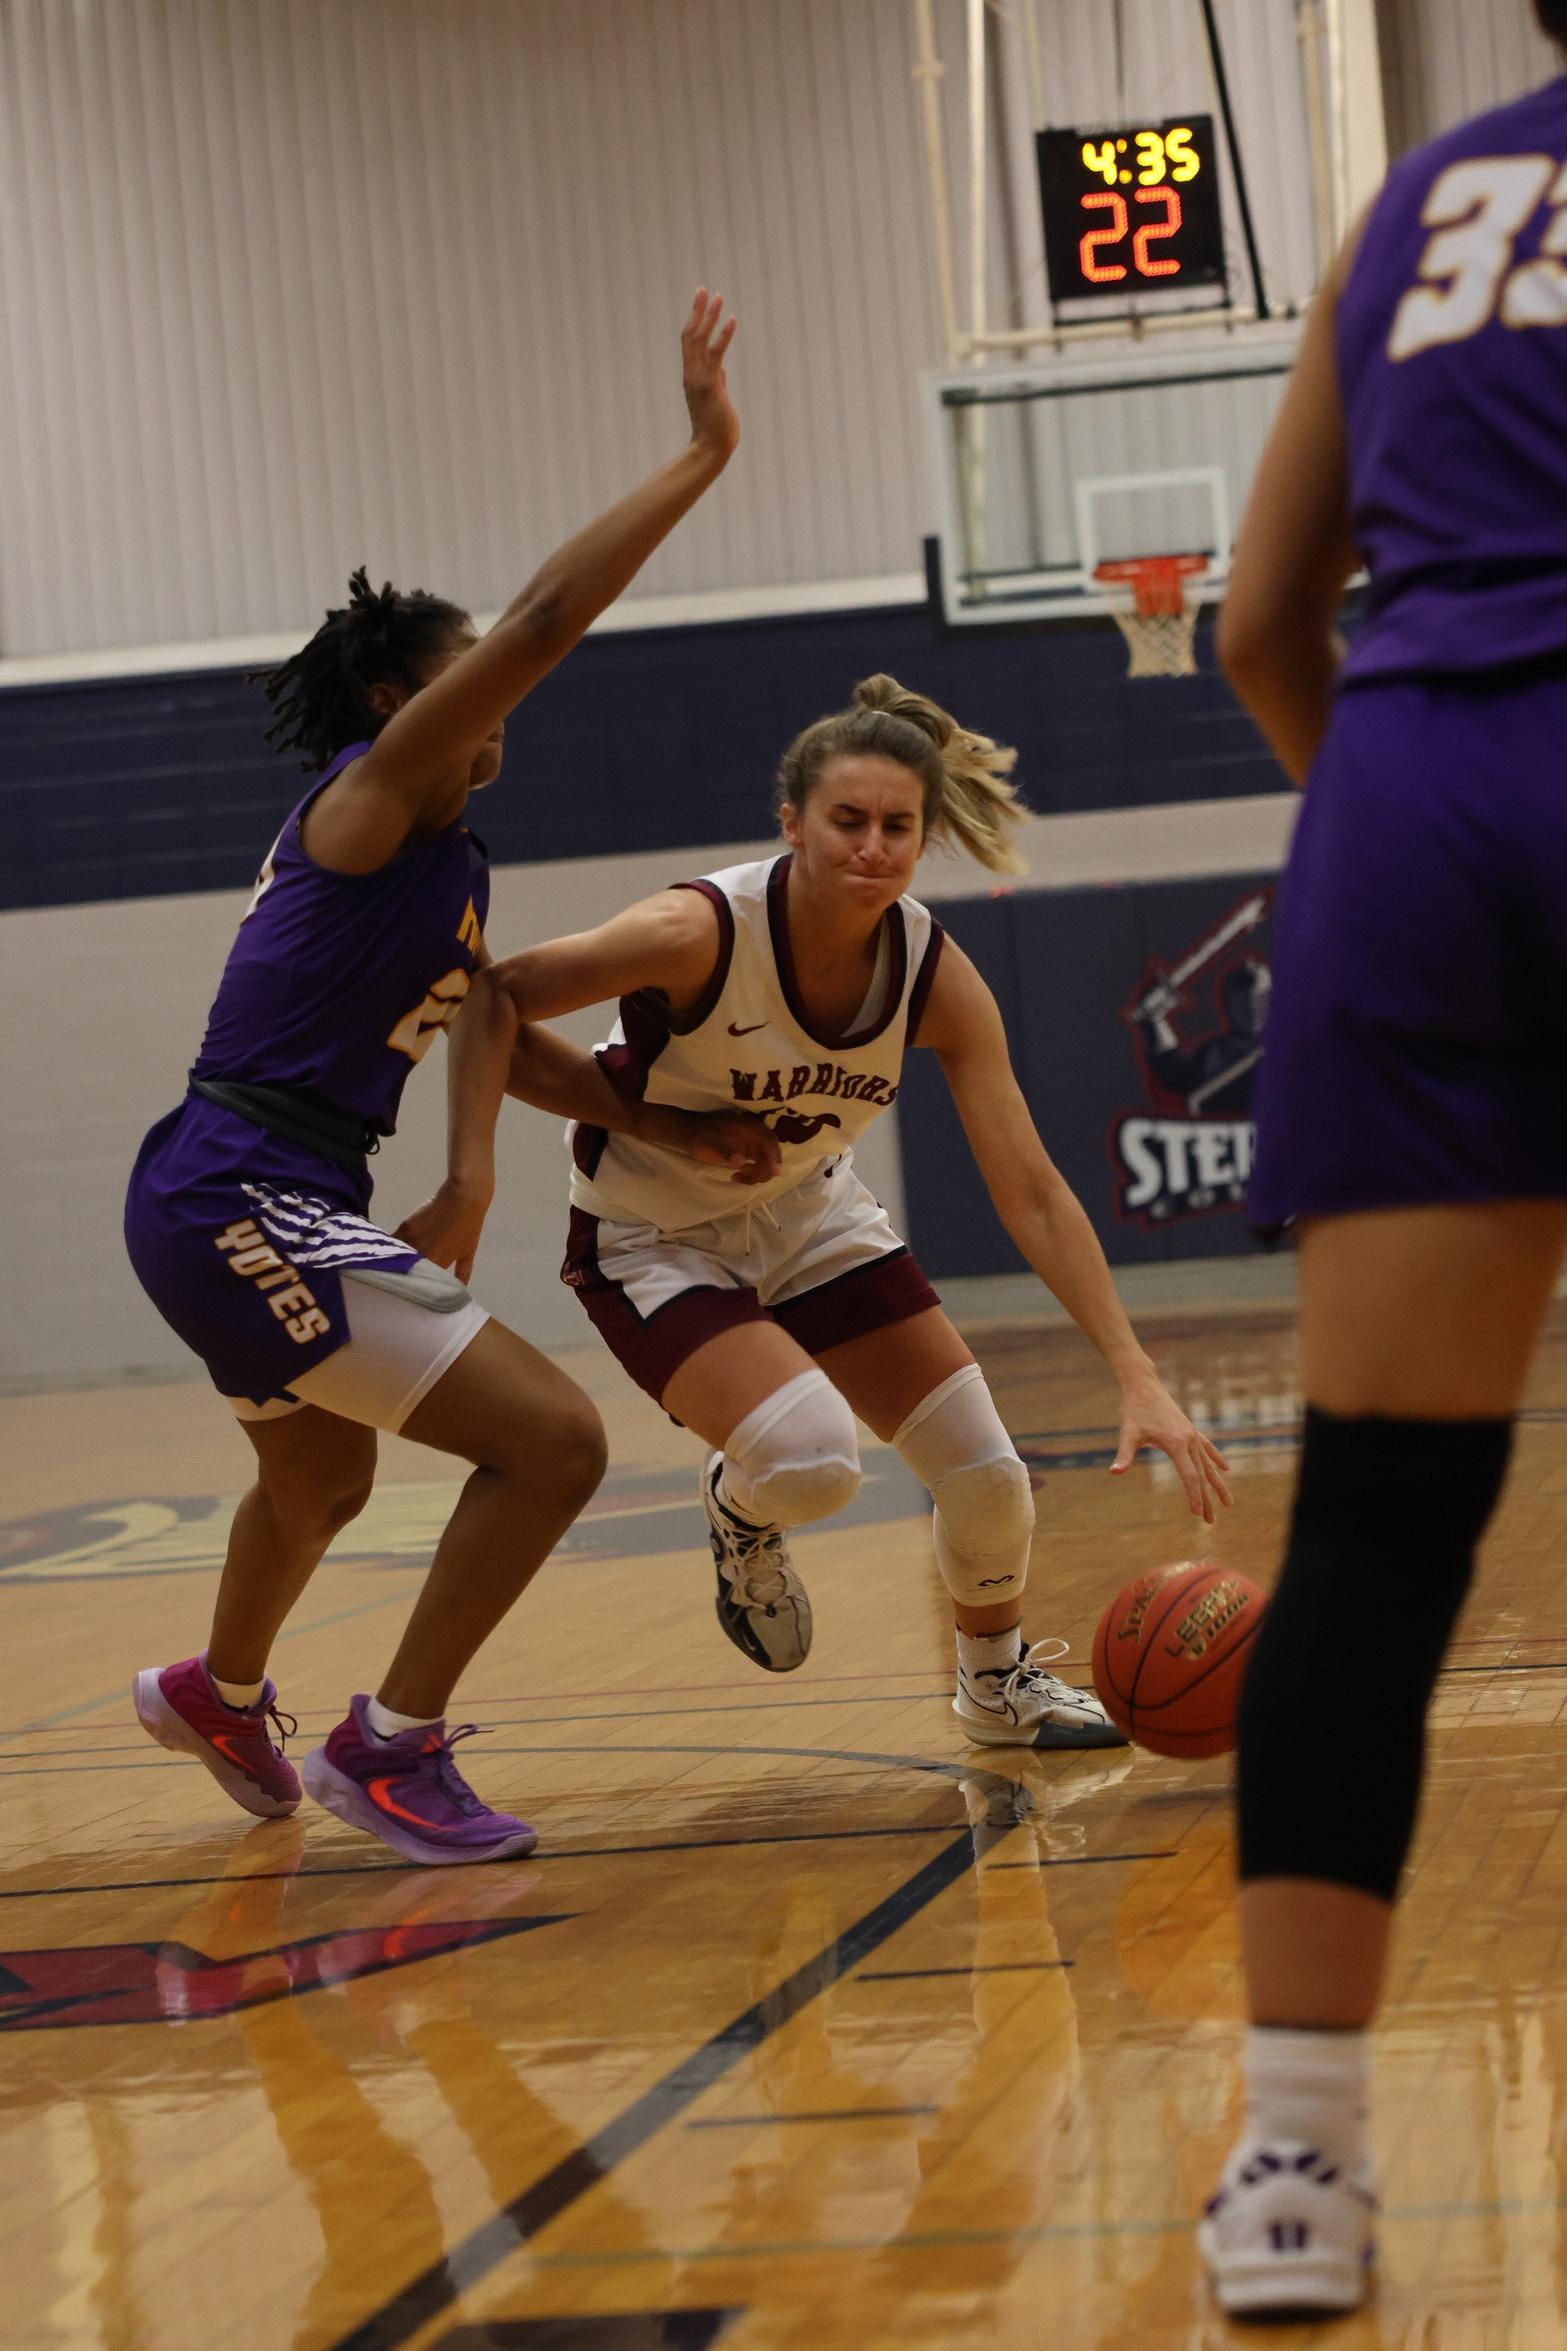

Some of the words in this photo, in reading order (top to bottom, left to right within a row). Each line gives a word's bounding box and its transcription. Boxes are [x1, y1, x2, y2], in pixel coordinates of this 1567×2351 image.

[1082, 127, 1200, 186] 4:35
[1079, 185, 1182, 283] 22
[729, 1062, 899, 1106] WARRIORS
[214, 1218, 331, 1345] YOTES
